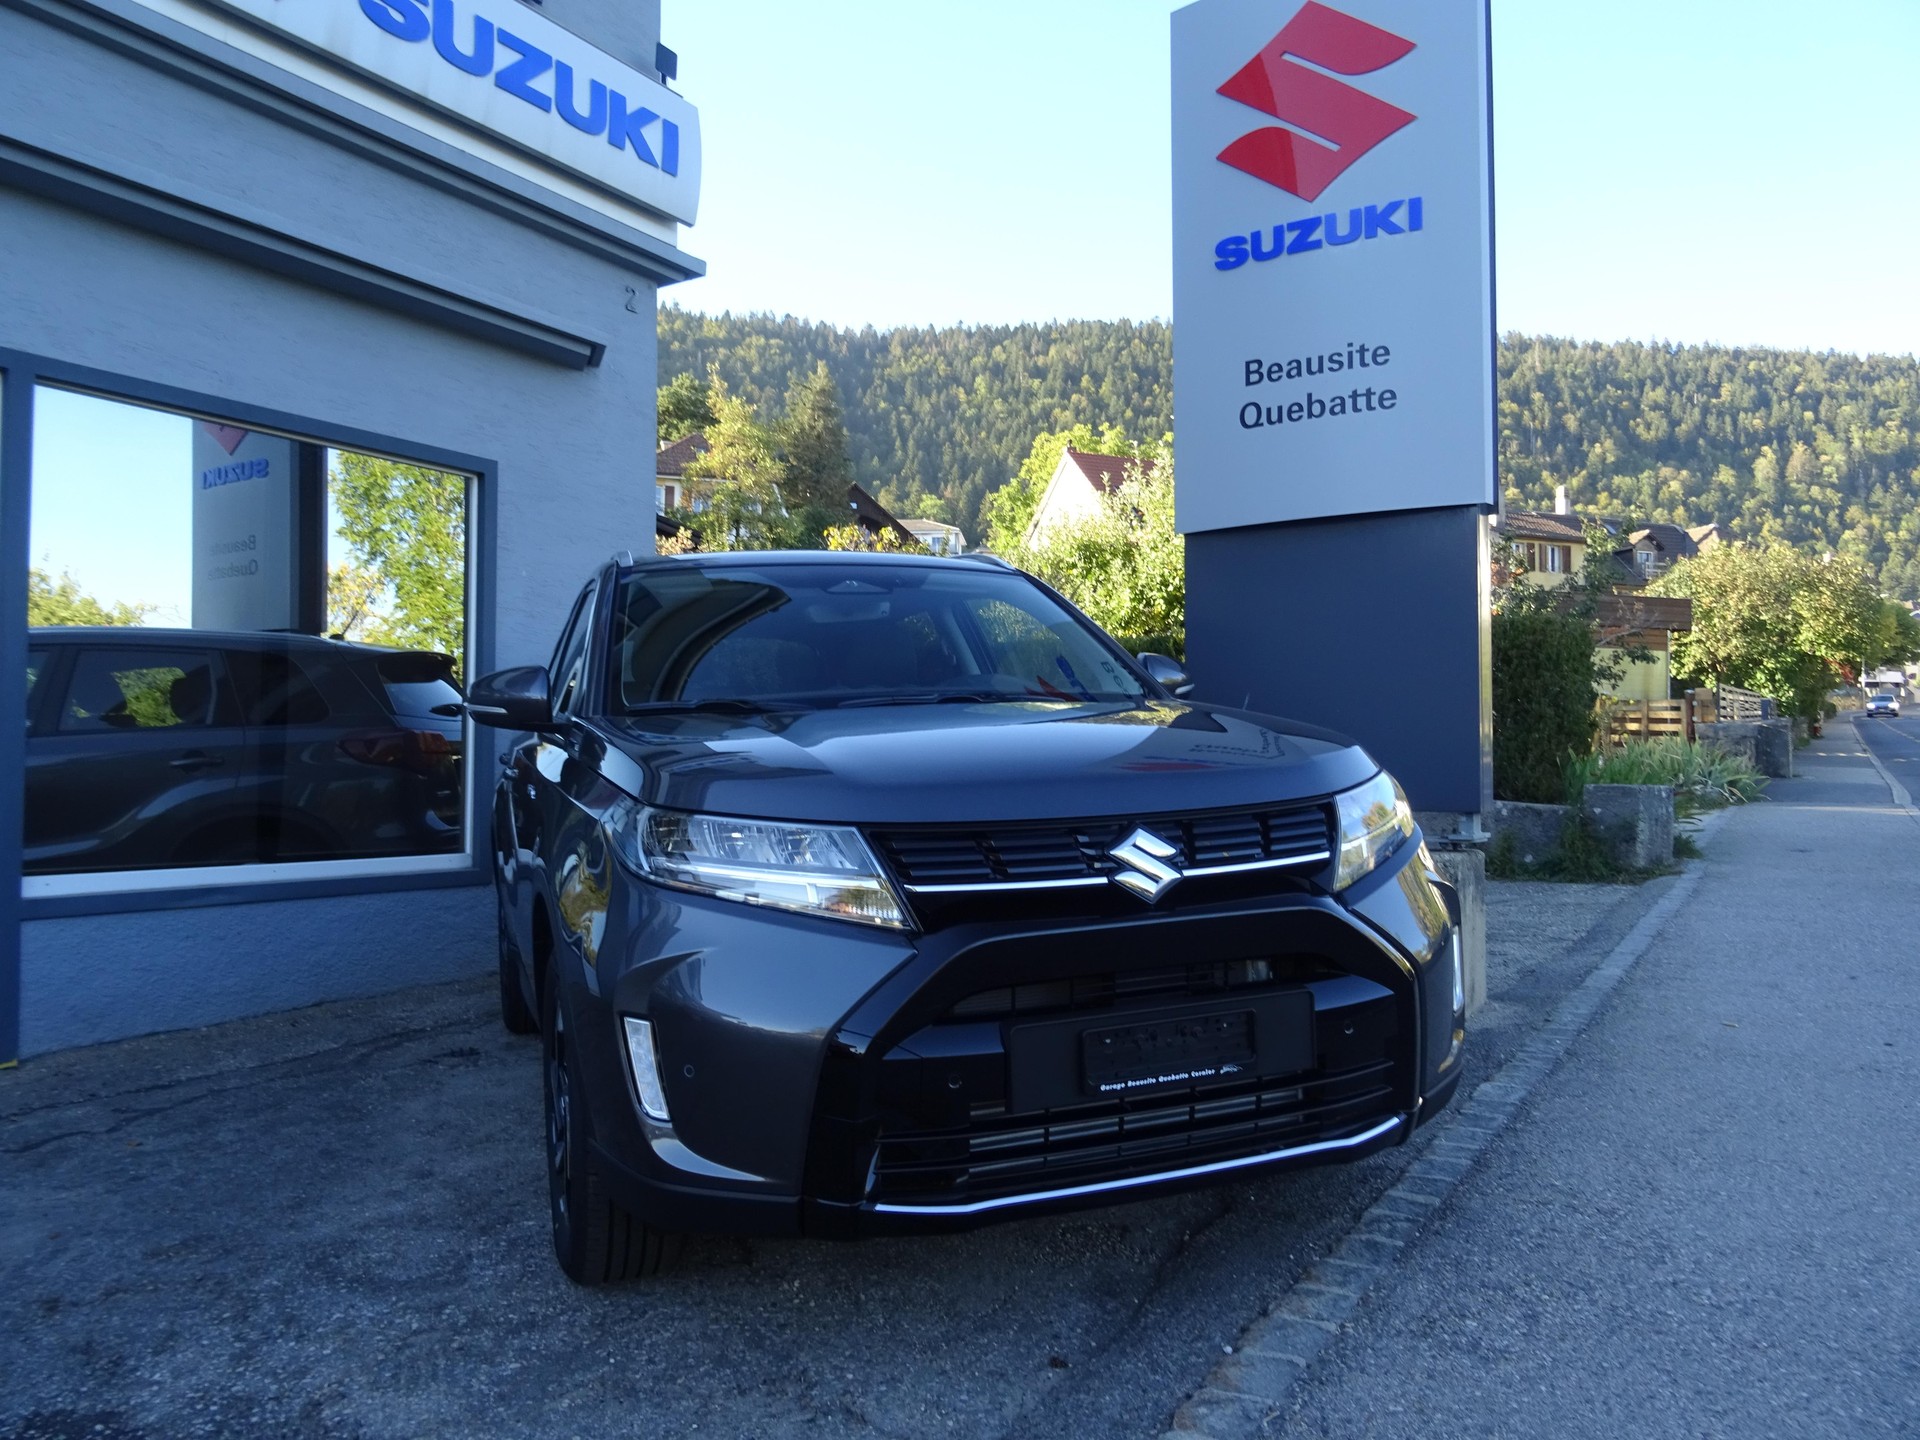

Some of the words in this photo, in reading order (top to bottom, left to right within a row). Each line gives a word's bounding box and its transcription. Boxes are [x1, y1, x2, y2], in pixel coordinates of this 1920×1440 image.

[1214, 196, 1423, 272] SUZUKI
[624, 286, 640, 315] 2
[1244, 342, 1391, 387] Beausite
[1239, 386, 1398, 430] Quebatte
[1100, 1082, 1126, 1092] Garage
[1127, 1077, 1157, 1088] Beausite
[1158, 1072, 1189, 1083] Quebatte
